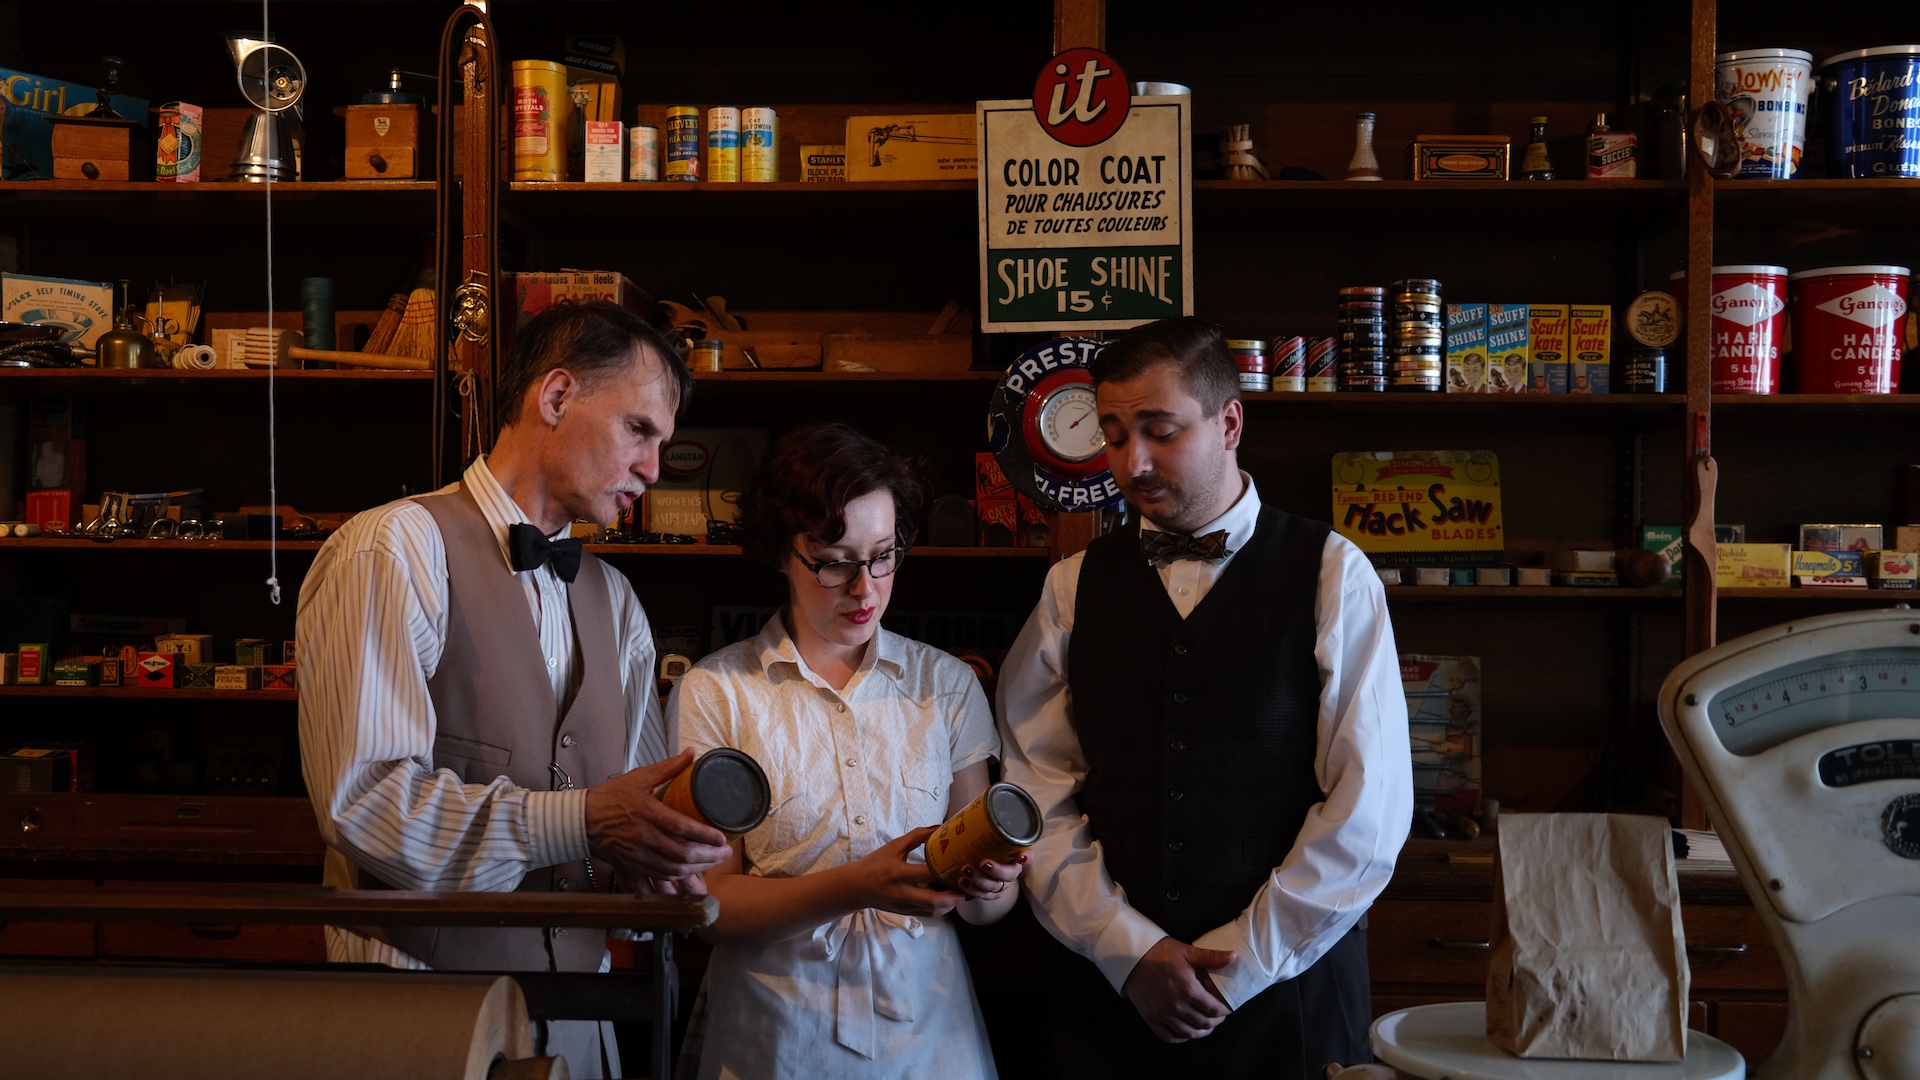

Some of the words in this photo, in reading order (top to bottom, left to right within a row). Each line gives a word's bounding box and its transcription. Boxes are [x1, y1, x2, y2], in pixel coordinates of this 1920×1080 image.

[1735, 67, 1802, 94] LOWNEY
[1848, 65, 1913, 101] Bédard
[6, 75, 67, 115] Girl
[1047, 59, 1112, 127] it
[1602, 148, 1630, 165] SUCCES
[808, 168, 829, 176] BLOCK
[1004, 158, 1080, 186] COLOR
[1100, 155, 1165, 184] COAT
[1005, 194, 1047, 214] POUR
[1053, 190, 1166, 212] CHAUSSURES
[1007, 220, 1028, 235] DE
[1034, 218, 1091, 234] TOUTES
[1097, 215, 1168, 233] COULEURS
[593, 273, 614, 285] Heels
[997, 257, 1070, 305] SHOE
[1090, 255, 1173, 305] SHINE
[36, 287, 54, 296] SELF
[59, 287, 86, 302] TIMING
[88, 300, 109, 319] STOVE
[1057, 290, 1095, 313] 15
[1448, 307, 1484, 326] SCUFF
[1490, 307, 1526, 326] SCUFF
[1530, 318, 1567, 335] Scuff
[1572, 318, 1609, 335] Scuff
[1448, 328, 1485, 348] SHINE
[1489, 329, 1526, 348] SHINE
[1534, 335, 1563, 351] kote
[1575, 336, 1605, 351] kote
[1830, 347, 1902, 361] CANDIES
[1857, 366, 1866, 375] 5
[666, 453, 704, 462] LANGTAN
[1391, 459, 1439, 468] SIMONDS
[656, 495, 702, 506] WOMEN'S
[1337, 494, 1369, 503] Famous
[1343, 483, 1427, 536] Hack
[1428, 483, 1494, 526] Saw
[1432, 528, 1497, 540] BLADES
[1794, 555, 1836, 573] Honeymallo
[1725, 713, 1735, 726] 5
[1782, 690, 1791, 704] 4
[1799, 683, 1809, 691] 12
[1819, 684, 1827, 692] 8
[1859, 676, 1868, 690] 3
[1901, 676, 1907, 685] 8
[1835, 773, 1849, 784] NO
